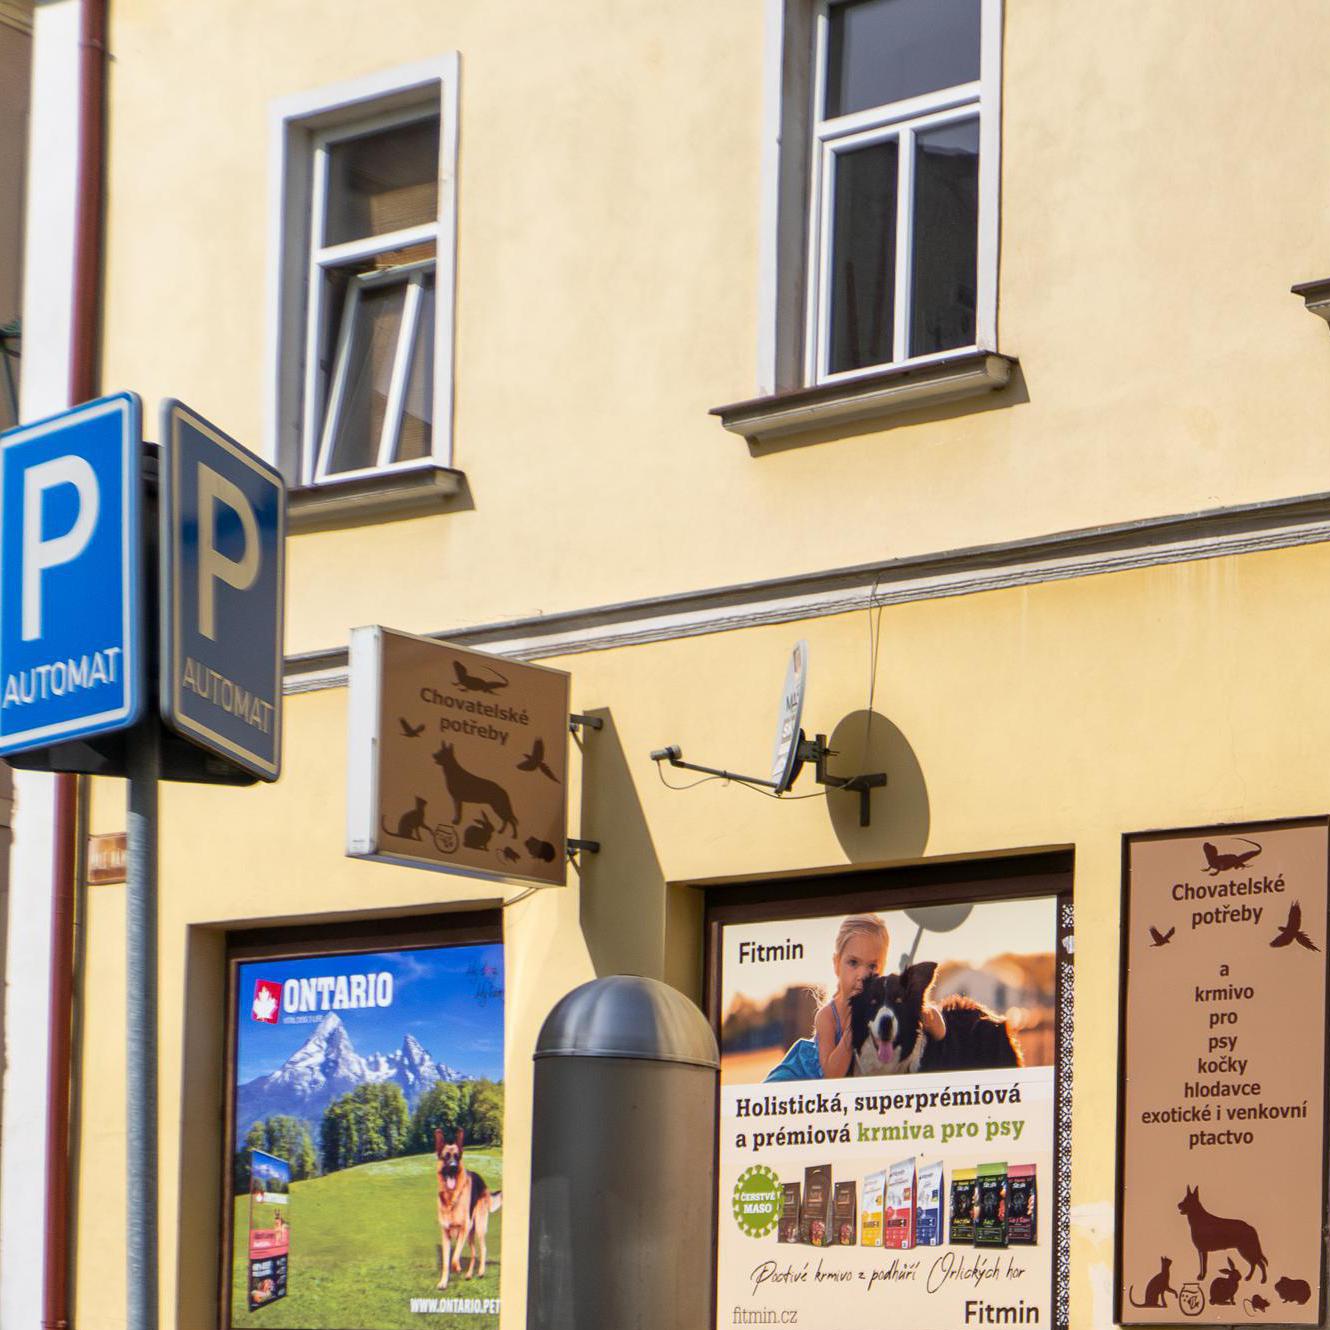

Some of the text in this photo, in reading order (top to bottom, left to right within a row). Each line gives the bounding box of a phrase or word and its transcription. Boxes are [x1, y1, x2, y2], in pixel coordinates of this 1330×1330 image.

[22, 454, 100, 642] P
[197, 461, 261, 642] P
[1, 647, 120, 708] AUTOMAT
[182, 656, 275, 733] AUTOMAT
[420, 687, 530, 725] Chovatelské
[440, 714, 509, 745] potřeby
[1172, 873, 1285, 901] Chovatelské
[1191, 905, 1263, 929] potřeby
[738, 939, 804, 965] Fitmin
[1219, 964, 1230, 978] a
[283, 971, 393, 1013] ONTARIO
[1195, 985, 1254, 1002] krmivo
[1209, 1011, 1238, 1028] pro
[1208, 1035, 1237, 1053] psy
[1198, 1056, 1248, 1074] kočky
[736, 1083, 1021, 1117] Holistická, superprémiová
[1184, 1081, 1261, 1098] hlodavce
[1141, 1101, 1307, 1124] exotické i venkovní
[736, 1118, 1025, 1152] a prémiová krmiva pro psy
[1189, 1130, 1254, 1149] ptactvo
[744, 1203, 773, 1213] MASO
[750, 1260, 809, 1296] Poctivé
[814, 1258, 852, 1283] krmivo
[867, 1259, 920, 1291] podhůří
[927, 1251, 1000, 1294] Orlických
[1006, 1256, 1026, 1281] hor
[732, 1304, 798, 1326] fitmin.cz
[965, 1299, 1039, 1325] Fitmin
